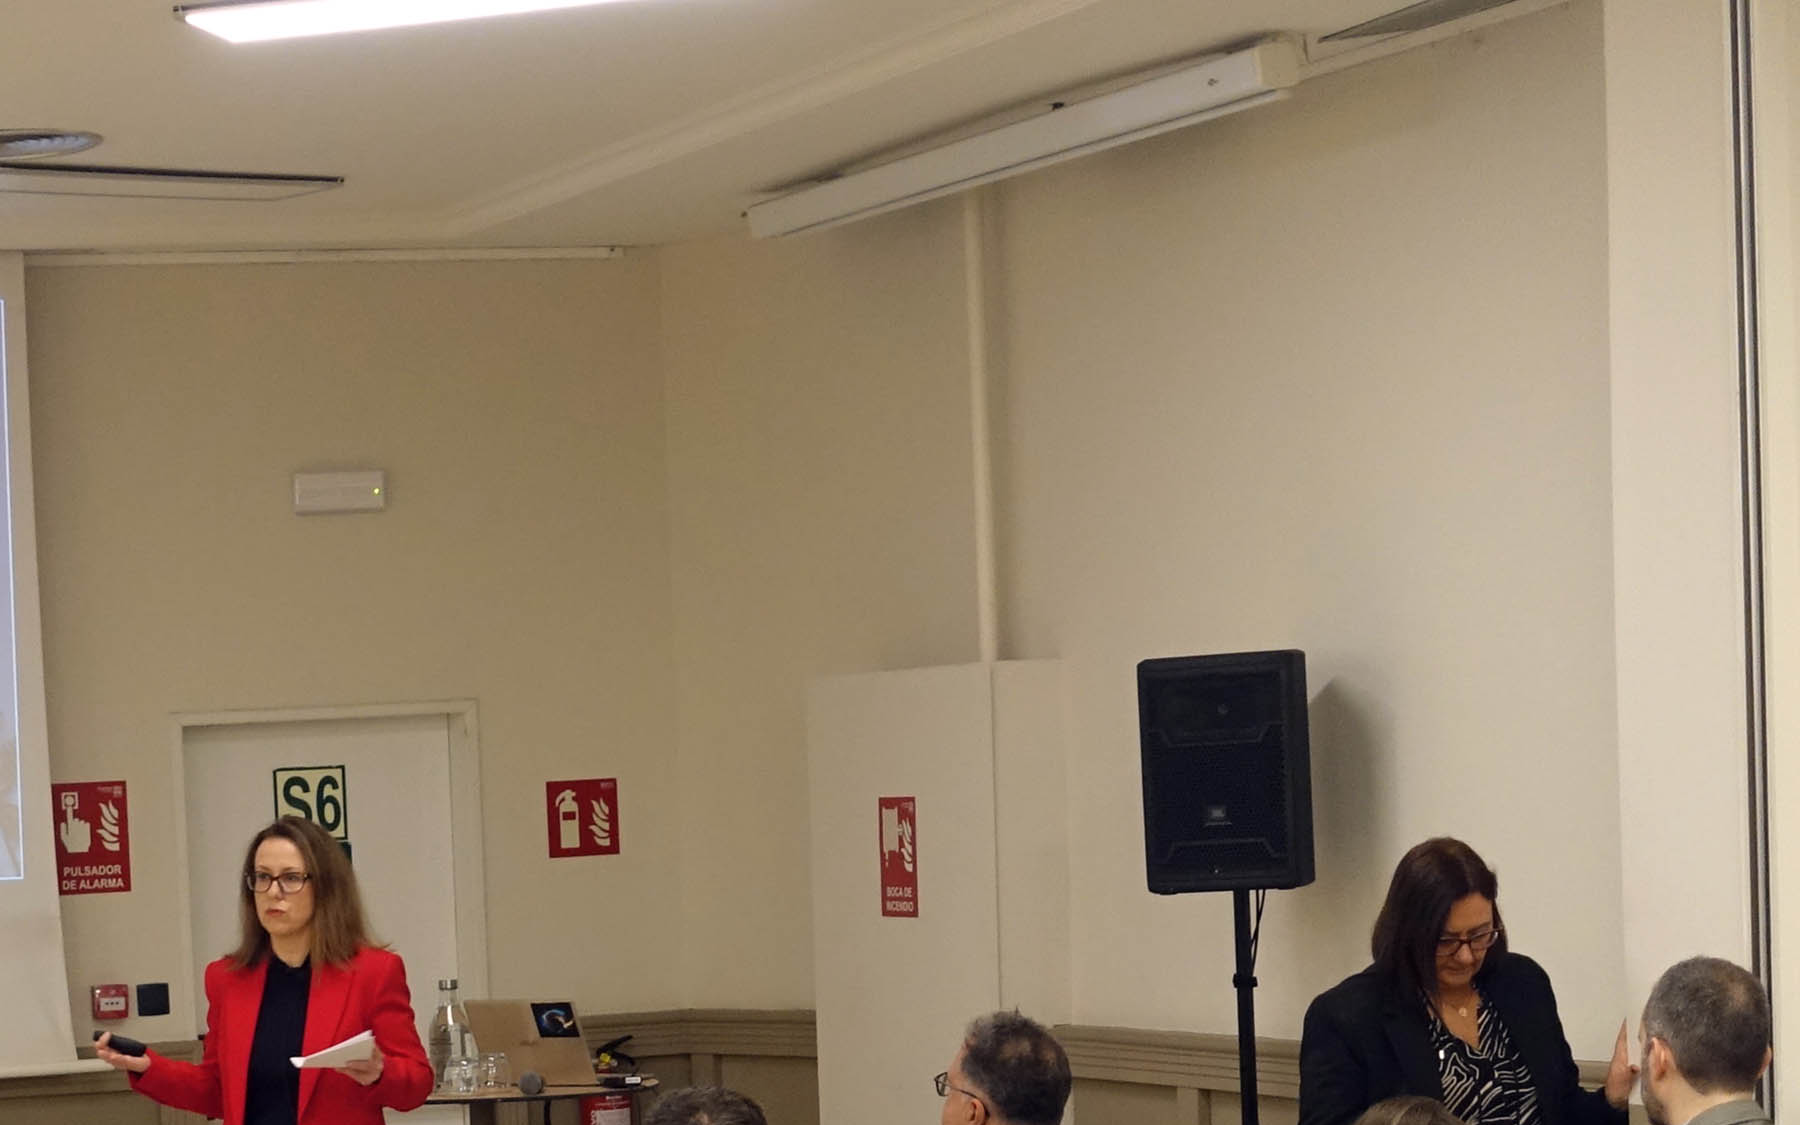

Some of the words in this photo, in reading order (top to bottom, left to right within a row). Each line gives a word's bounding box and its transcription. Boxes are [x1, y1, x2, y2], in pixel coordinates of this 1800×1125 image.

[283, 775, 342, 832] S6
[63, 864, 122, 877] PULSADOR
[62, 880, 77, 890] DE
[79, 878, 124, 890] ALARMA
